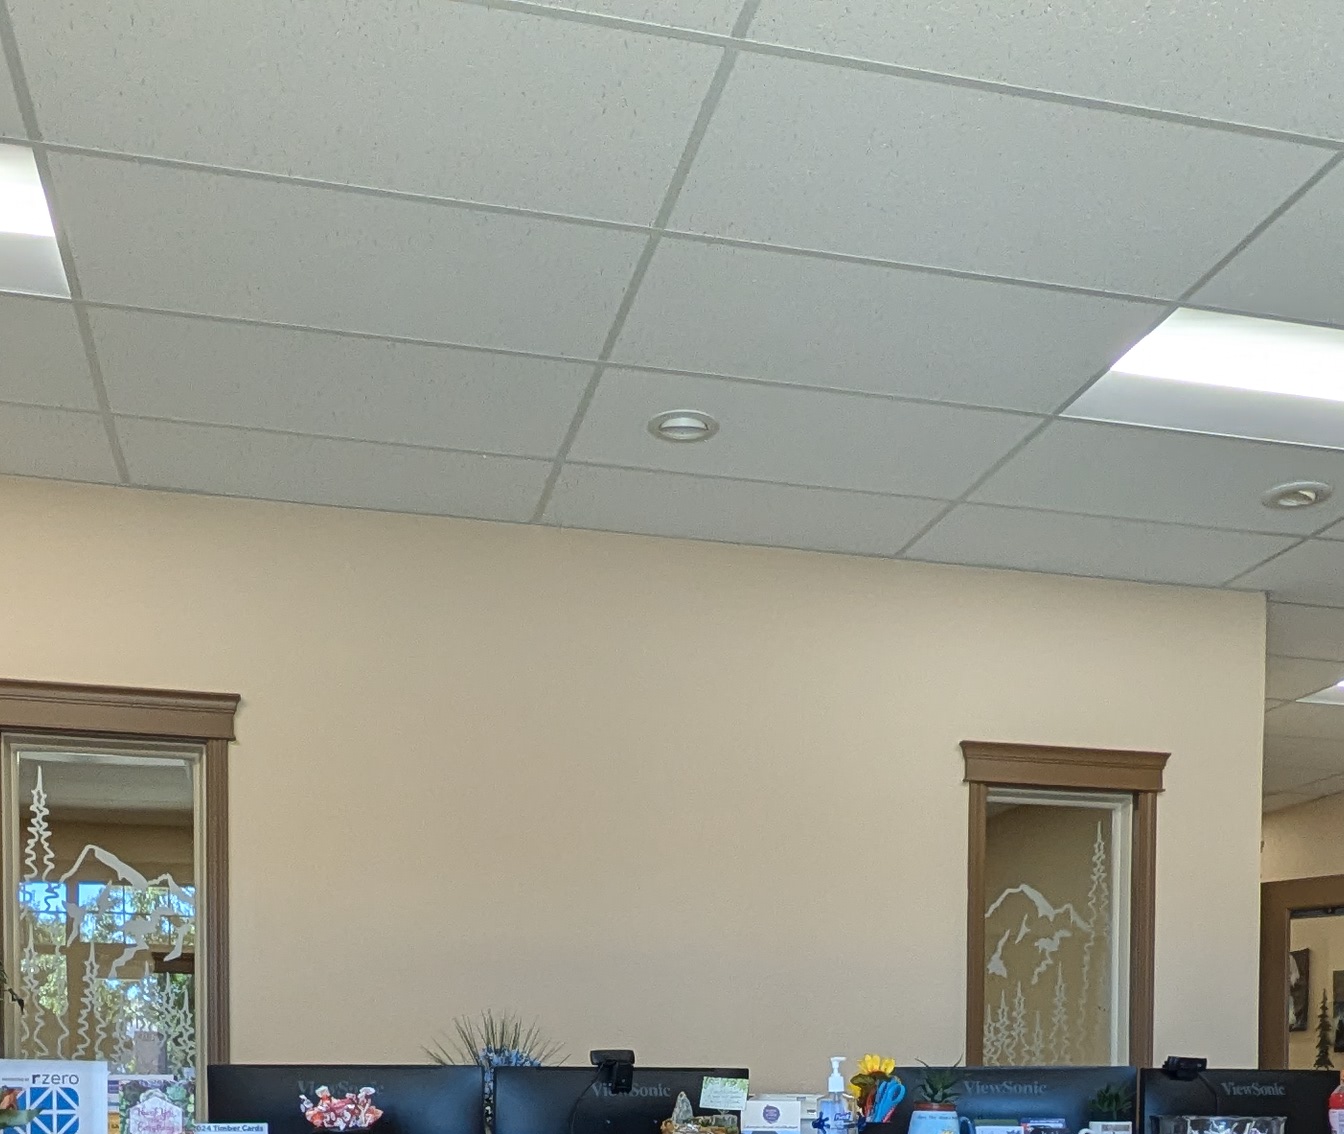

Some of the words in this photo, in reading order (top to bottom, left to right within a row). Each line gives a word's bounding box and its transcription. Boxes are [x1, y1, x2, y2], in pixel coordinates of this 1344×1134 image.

[32, 1074, 80, 1085] rzero
[592, 1082, 671, 1098] ViSonic
[963, 1080, 1048, 1096] ViewSonic
[1221, 1081, 1287, 1097] ViewSonic
